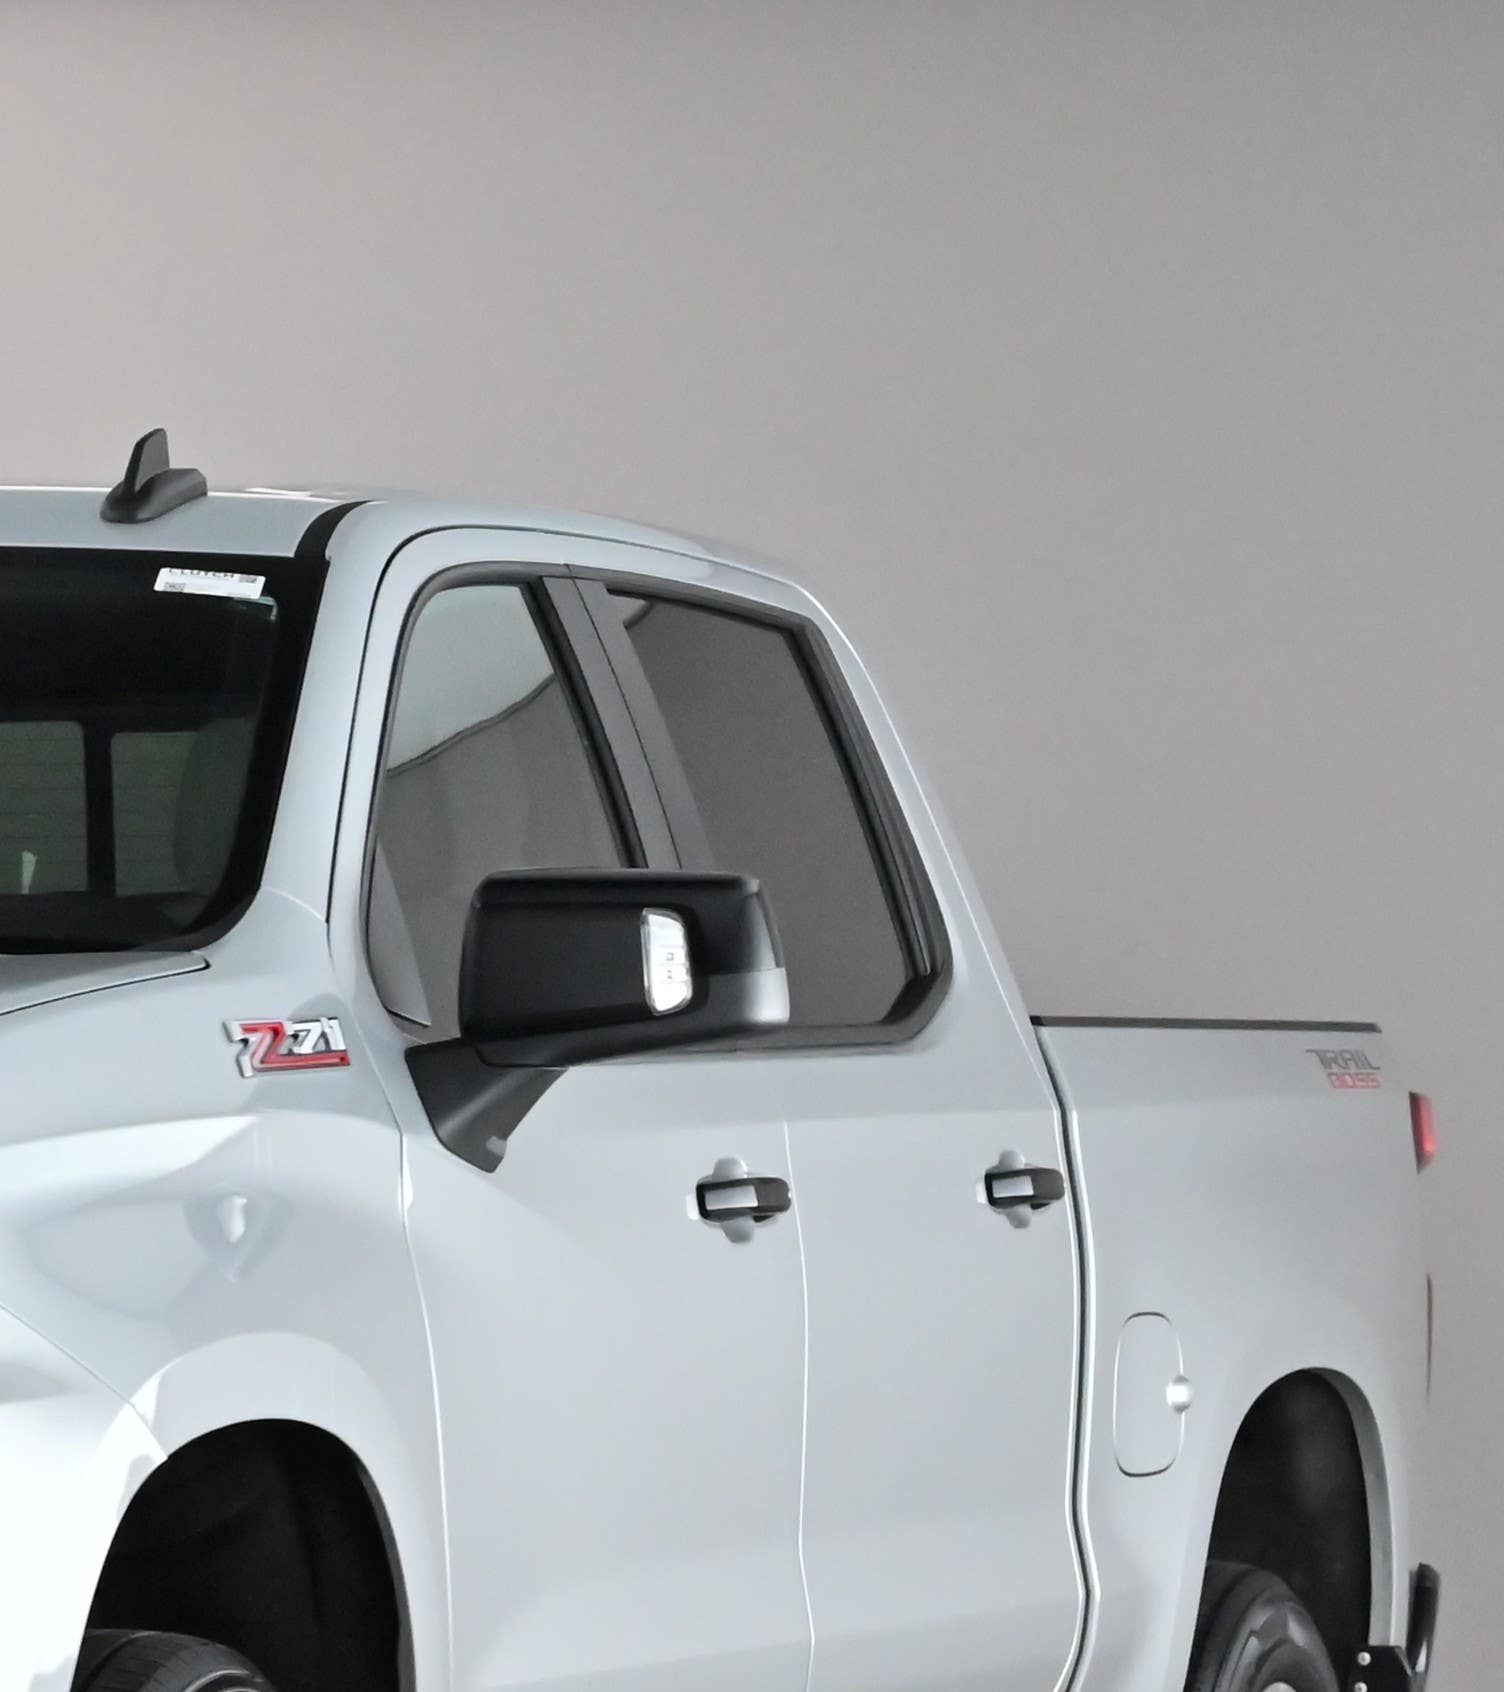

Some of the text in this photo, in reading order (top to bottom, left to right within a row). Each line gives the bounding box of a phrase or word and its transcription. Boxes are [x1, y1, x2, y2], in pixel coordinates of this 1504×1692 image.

[222, 1016, 352, 1079] Z71
[1305, 1048, 1381, 1070] TRAIL
[1327, 1071, 1381, 1089] BOSS
